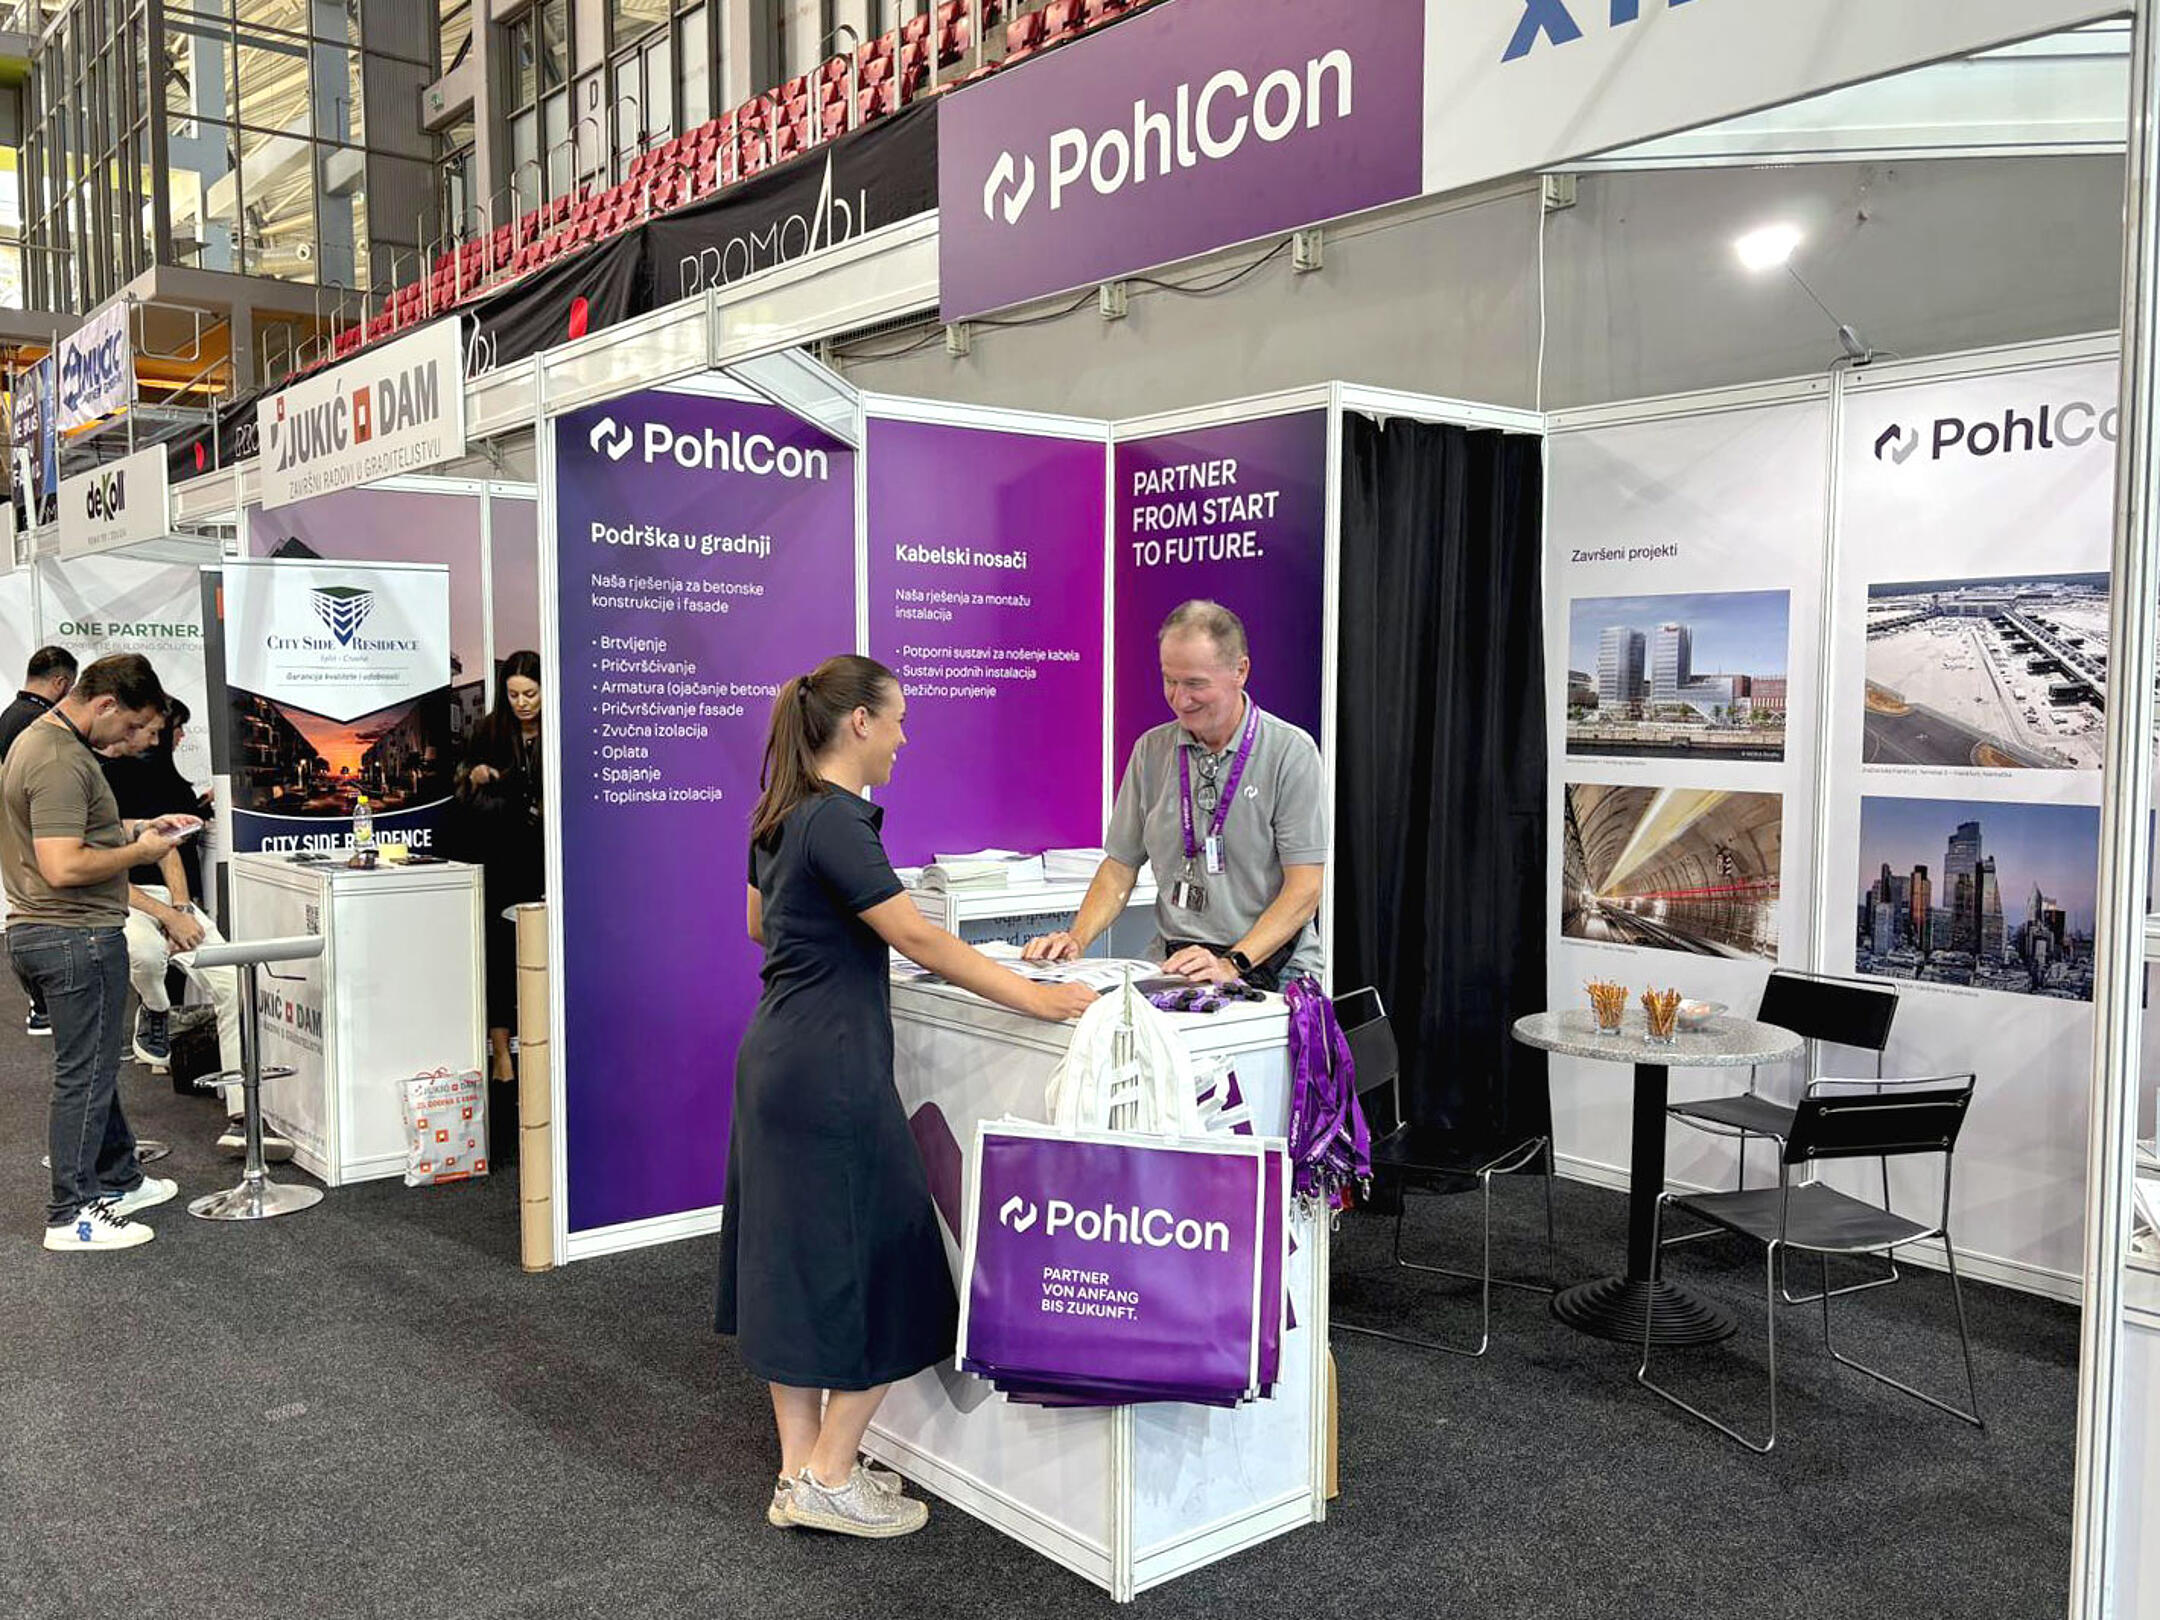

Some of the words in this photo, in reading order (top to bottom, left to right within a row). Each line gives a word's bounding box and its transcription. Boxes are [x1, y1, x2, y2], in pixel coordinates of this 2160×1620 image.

[1050, 49, 1353, 210] PohlCon
[287, 378, 348, 468] JUKIĆ
[378, 359, 440, 436] DAM
[1932, 402, 2118, 460] PohlCo
[644, 422, 828, 480] PohlCon
[323, 461, 354, 489] RADOVI
[1133, 458, 1237, 497] PARTNER
[1133, 502, 1197, 533] FROM
[1202, 491, 1280, 525] START
[590, 522, 680, 549] Podrška
[684, 536, 696, 550] u
[700, 533, 771, 559] gradnji
[1132, 541, 1161, 567] TO
[1165, 531, 1264, 564] FUTURE.
[896, 543, 971, 566] Kabelski
[973, 551, 1028, 569] nosači
[1571, 547, 1625, 562] Završeni
[1628, 543, 1678, 562] projekti
[591, 574, 626, 590] Naša
[628, 576, 683, 594] rješenja
[685, 581, 700, 592] za
[703, 580, 765, 596] betonske
[591, 593, 674, 612] konstrukcije
[683, 598, 729, 613] fasade
[896, 589, 925, 602] Naša
[926, 591, 970, 606] rješenja
[971, 595, 984, 605] za
[985, 594, 1031, 607] montažu
[896, 606, 952, 622] instalacija
[59, 622, 102, 636] ONE
[108, 623, 204, 638] PARTNER.
[267, 635, 300, 650] CITY
[302, 636, 335, 651] SIDE
[352, 637, 420, 651] RESIDENCE
[601, 636, 667, 654] Brtvljenje
[903, 645, 952, 662] Potporni
[953, 647, 991, 660] sustavi
[993, 650, 1005, 660] za
[1005, 648, 1047, 662] nošenje
[1047, 650, 1080, 661] kabela
[601, 659, 696, 676] Pričvršćivanje
[903, 666, 944, 678] Sustavi
[945, 667, 984, 680] podnih
[985, 667, 1037, 681] instalacija
[601, 681, 665, 694] Armatura
[667, 682, 728, 697] (ojačanje
[903, 684, 948, 697] Bežično
[950, 685, 997, 699] punjenje
[601, 703, 696, 719] Pričvršćivanje
[698, 704, 744, 716] fasade
[602, 724, 651, 737] Zvučna
[654, 724, 708, 740] izolacija
[602, 745, 649, 760] Oplata
[602, 766, 661, 783] Spajanje
[603, 788, 667, 805] Toplinska
[669, 786, 723, 801] izolacija
[261, 835, 299, 853] CITY
[303, 833, 342, 852] SIDE
[345, 829, 432, 850] RIDENCE
[258, 989, 282, 1020] UKIĆ
[296, 1003, 322, 1039] DAM
[1046, 1200, 1230, 1252] PohlCon
[1043, 1266, 1109, 1285] PARTNER
[1042, 1283, 1075, 1299] VON
[1077, 1287, 1139, 1304] ANFANG
[1041, 1299, 1064, 1313] BIS
[1066, 1301, 1138, 1321] ZUKUNFT.
